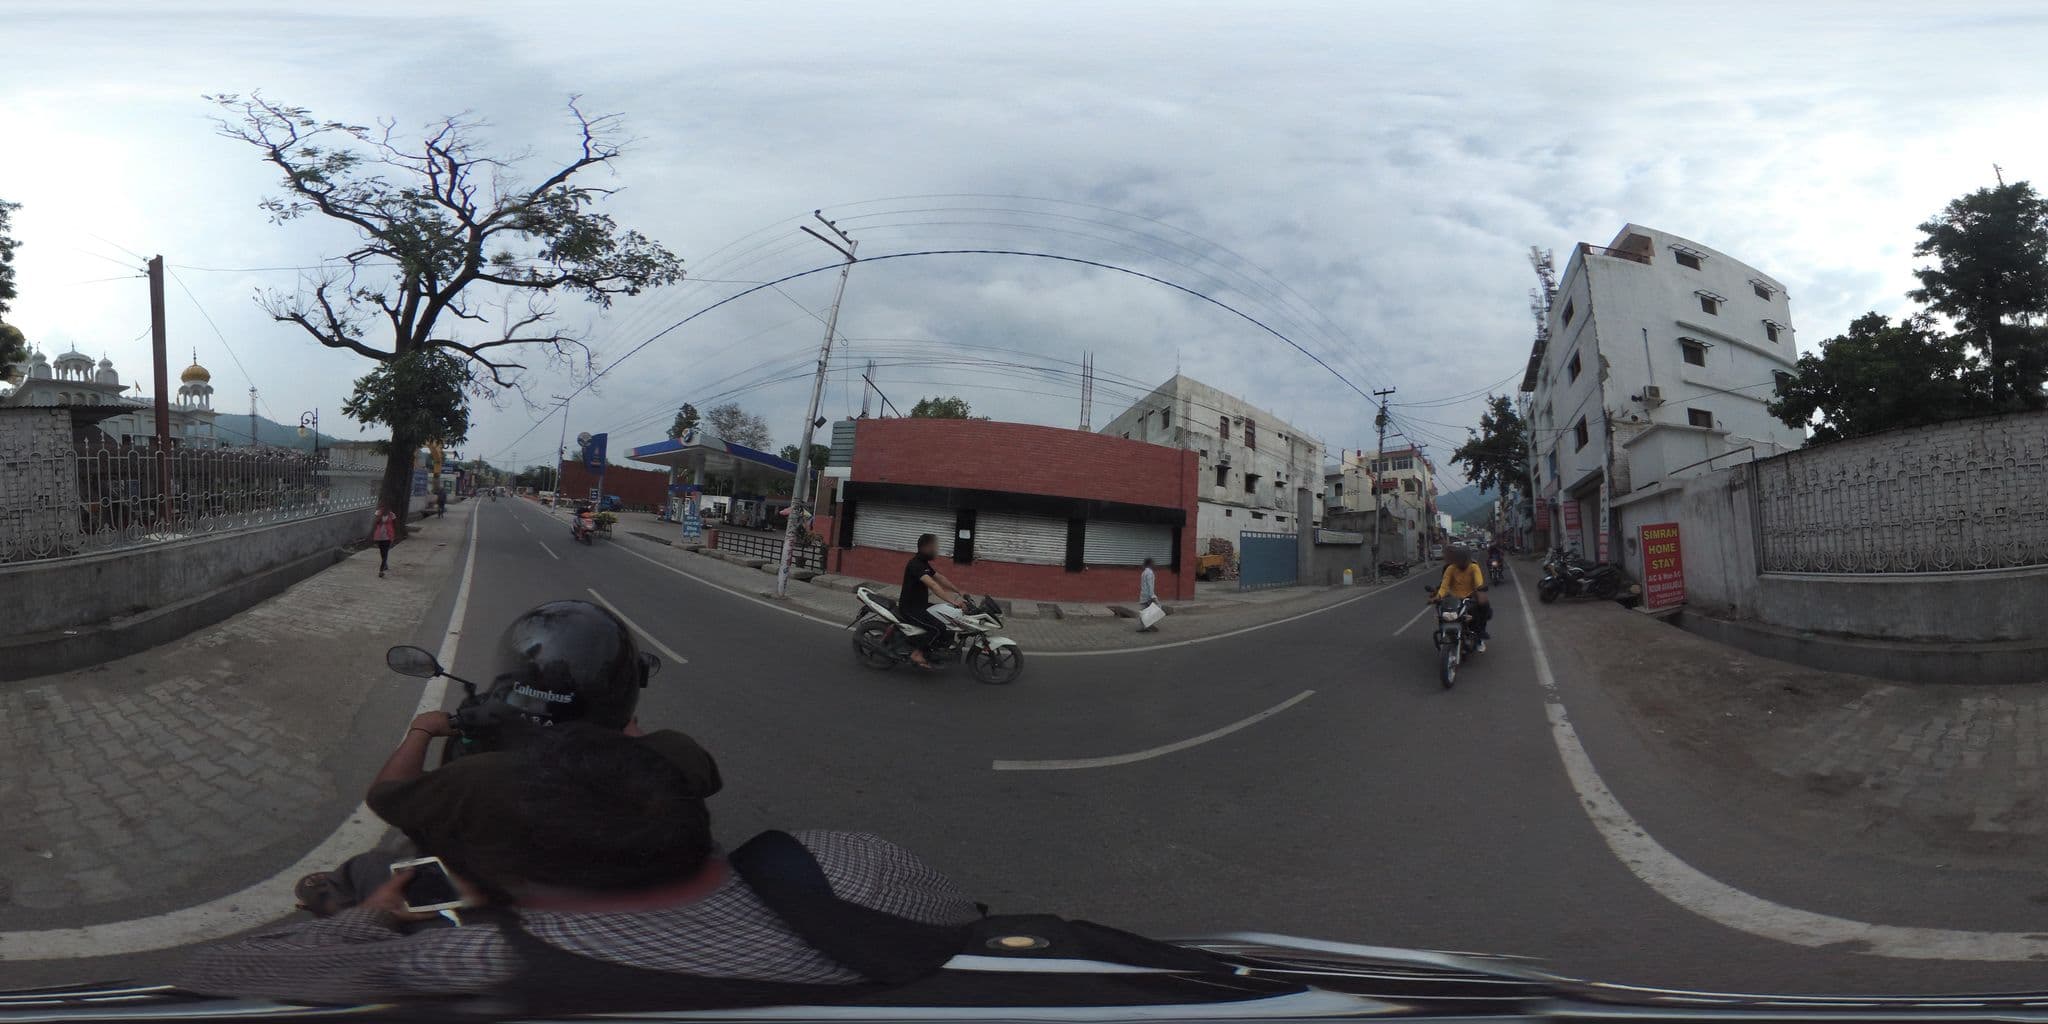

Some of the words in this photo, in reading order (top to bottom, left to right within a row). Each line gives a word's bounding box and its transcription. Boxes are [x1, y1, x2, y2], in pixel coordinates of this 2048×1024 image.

[1643, 528, 1678, 540] SIMRAN
[1648, 543, 1677, 554] HOME
[1652, 558, 1676, 569] STAY
[513, 681, 572, 703] Columbus
